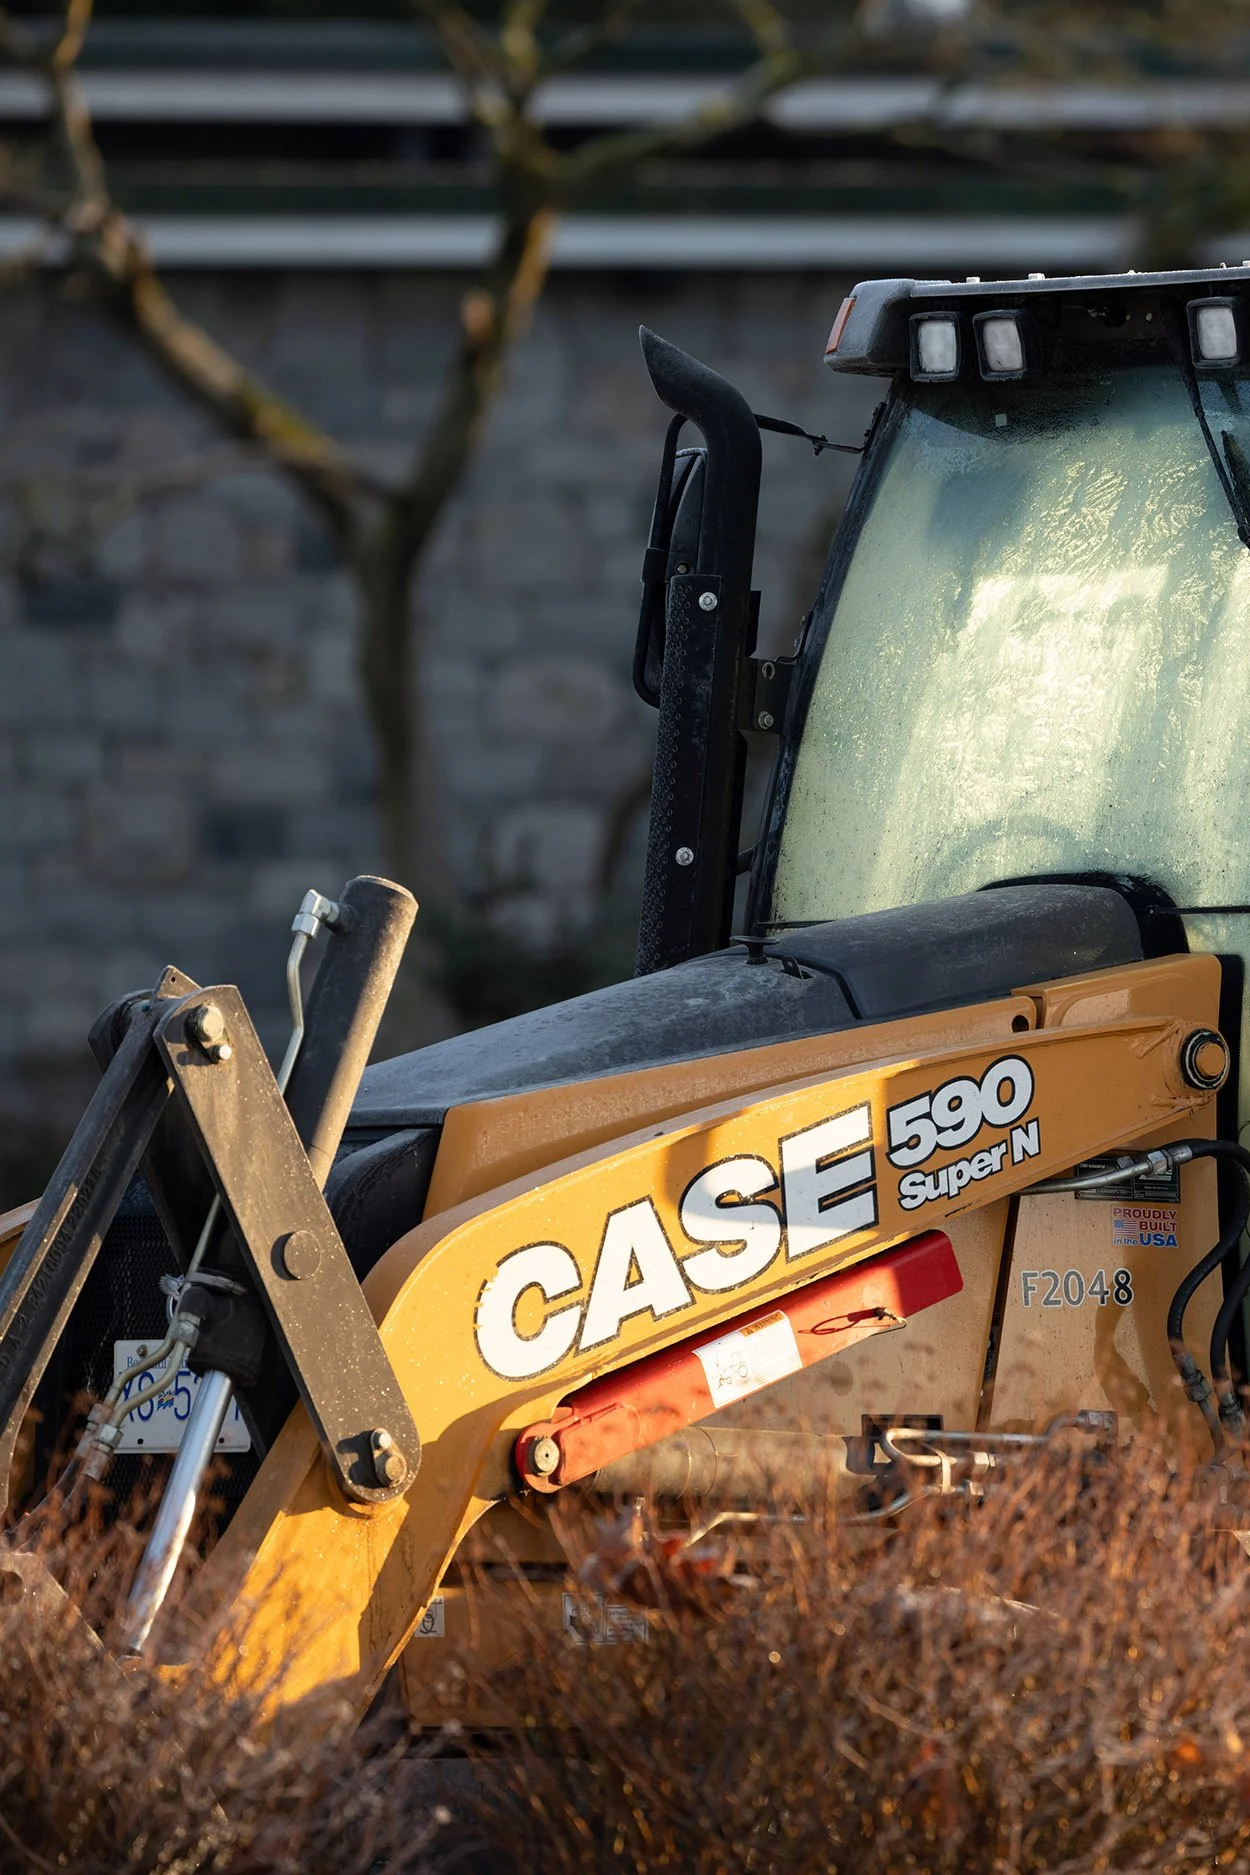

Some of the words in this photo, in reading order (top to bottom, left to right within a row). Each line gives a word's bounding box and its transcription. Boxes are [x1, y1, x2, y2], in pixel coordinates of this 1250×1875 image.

[885, 1054, 1035, 1170] 590
[898, 1139, 1008, 1211] Super
[1009, 1116, 1041, 1166] N
[1113, 1207, 1177, 1220] PROUDLY
[1139, 1221, 1178, 1232] BUILT
[473, 1100, 880, 1382] CASE
[1113, 1237, 1123, 1245] in
[1139, 1232, 1178, 1248] USA
[1020, 1268, 1135, 1308] F2048
